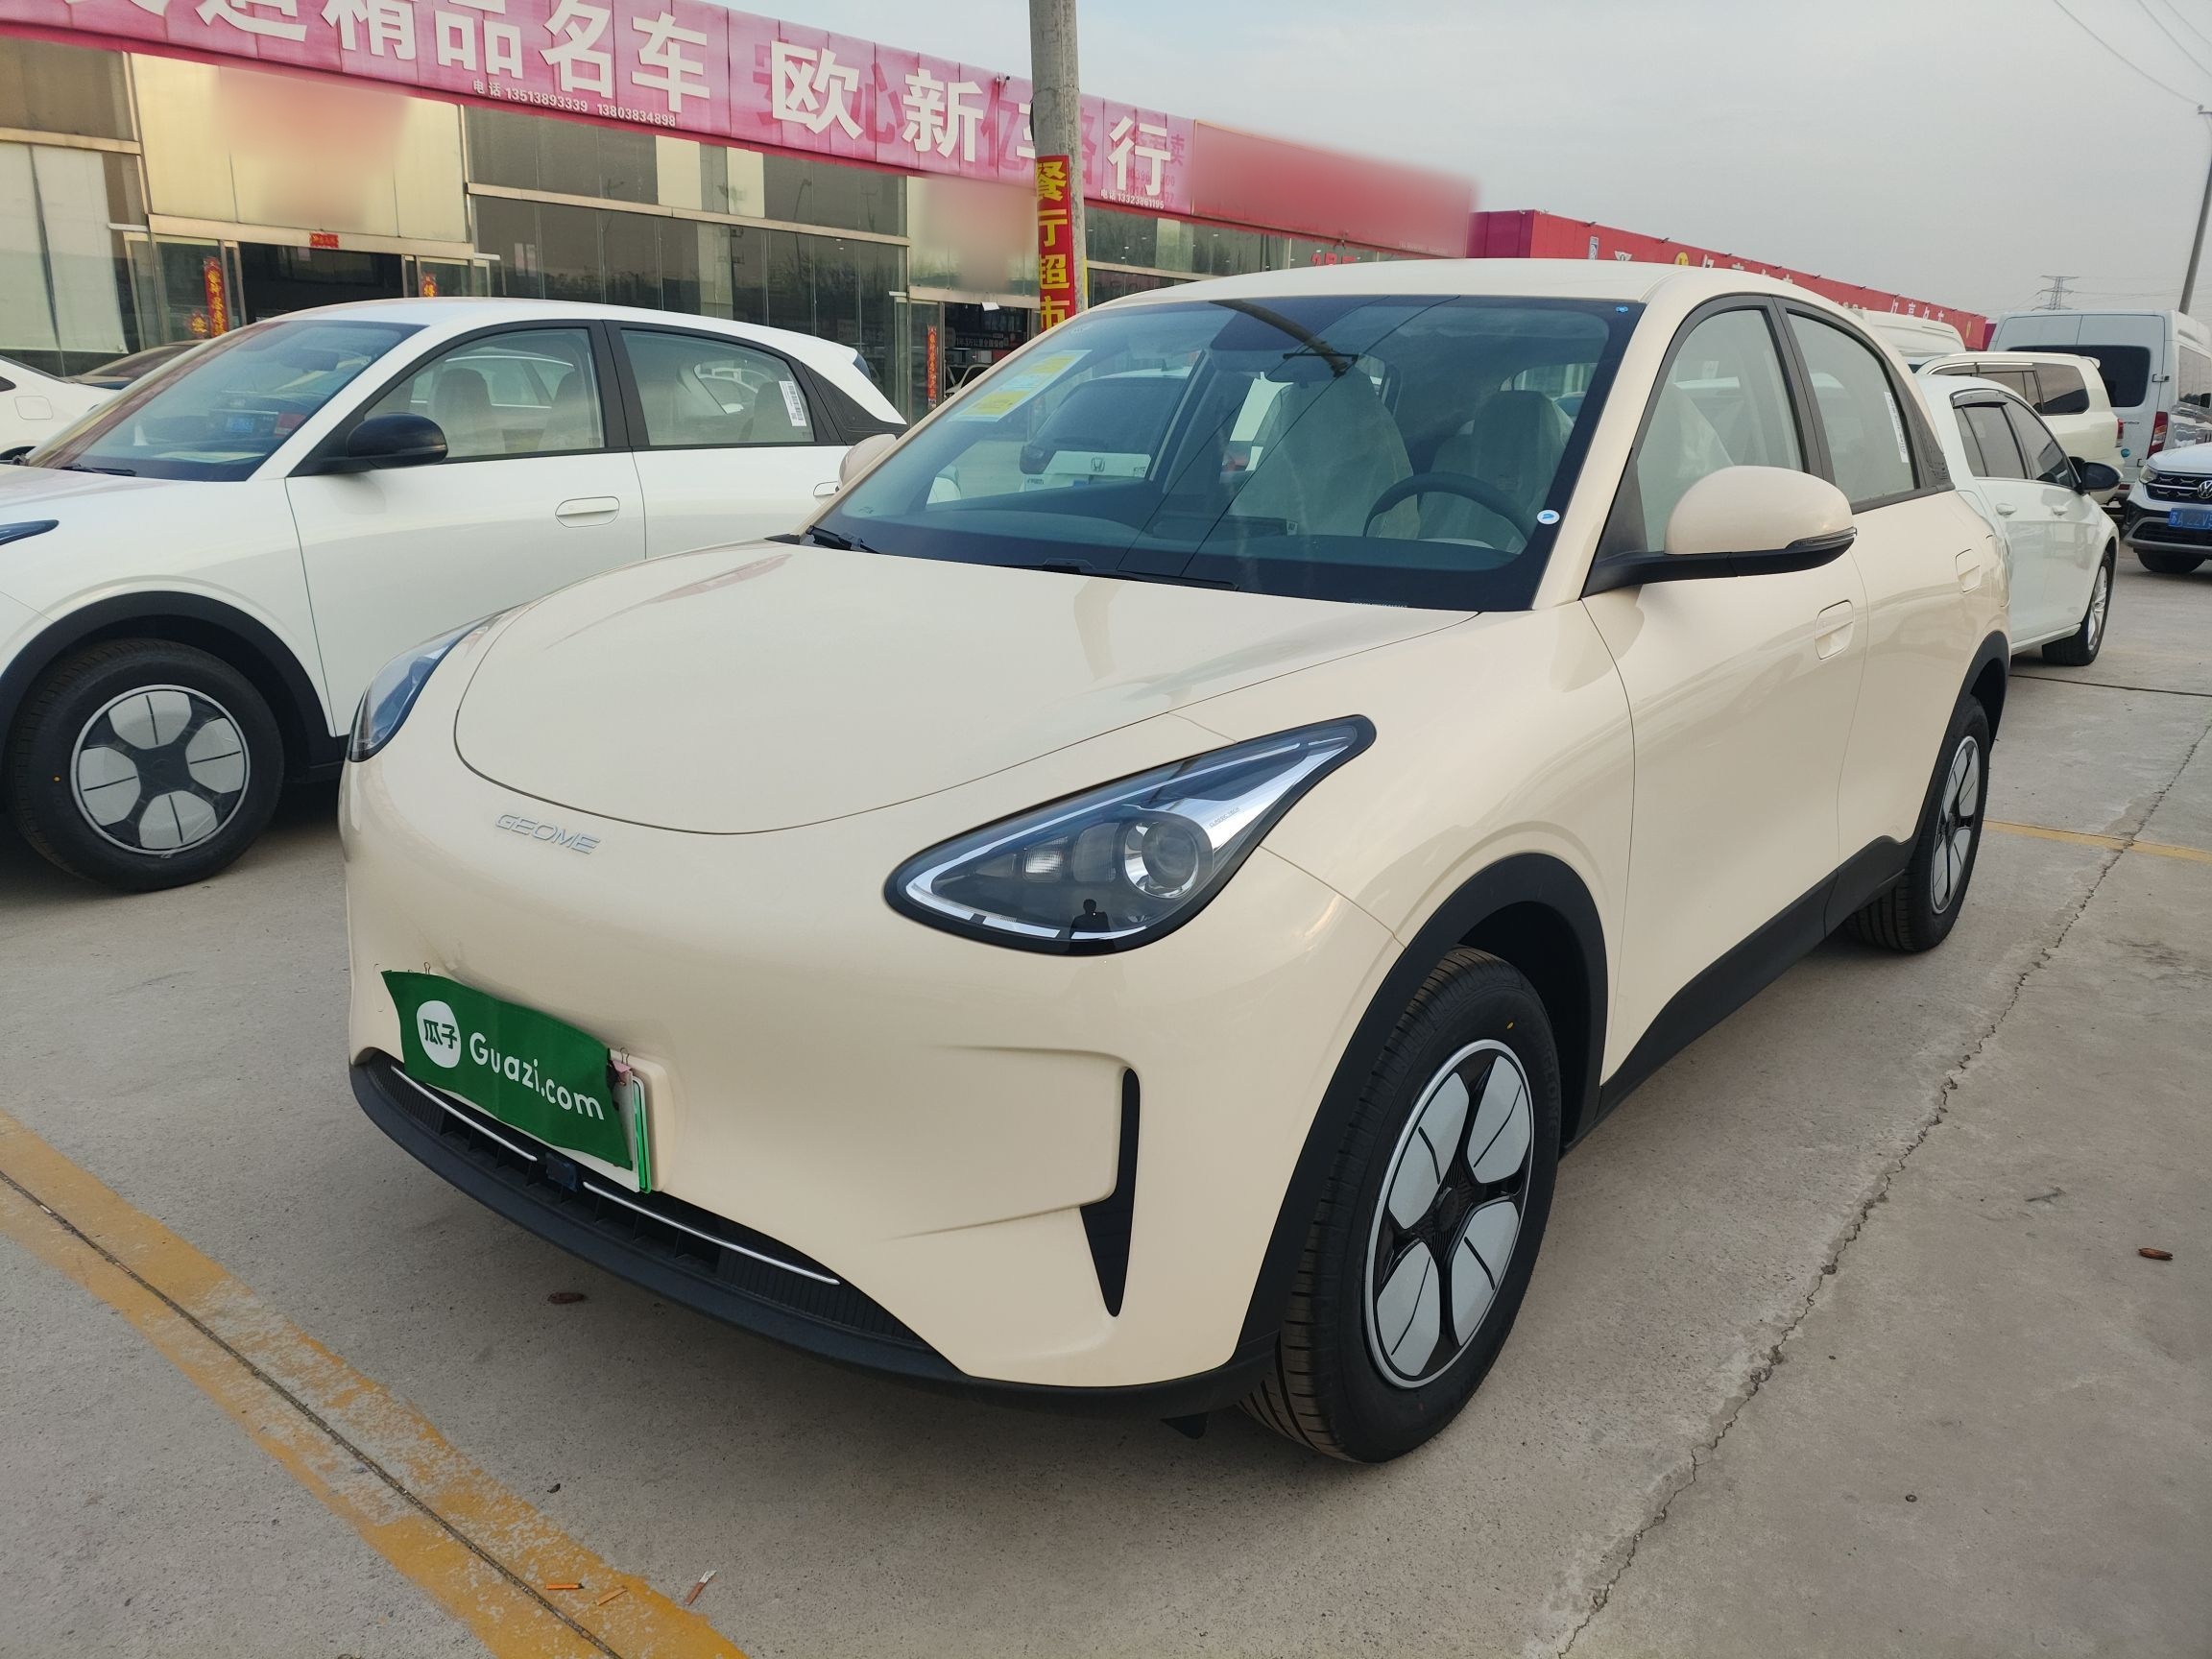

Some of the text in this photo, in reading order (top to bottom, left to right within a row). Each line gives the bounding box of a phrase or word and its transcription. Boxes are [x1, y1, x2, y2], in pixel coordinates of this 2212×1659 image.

[65, 0, 709, 112] 精品名车
[472, 80, 676, 127] 电话 13513893339 13803834898
[770, 39, 1171, 197] 欧新行
[495, 814, 601, 854] GEOME
[423, 1019, 458, 1049] 瓜子
[469, 1032, 605, 1120] Guazi.com
